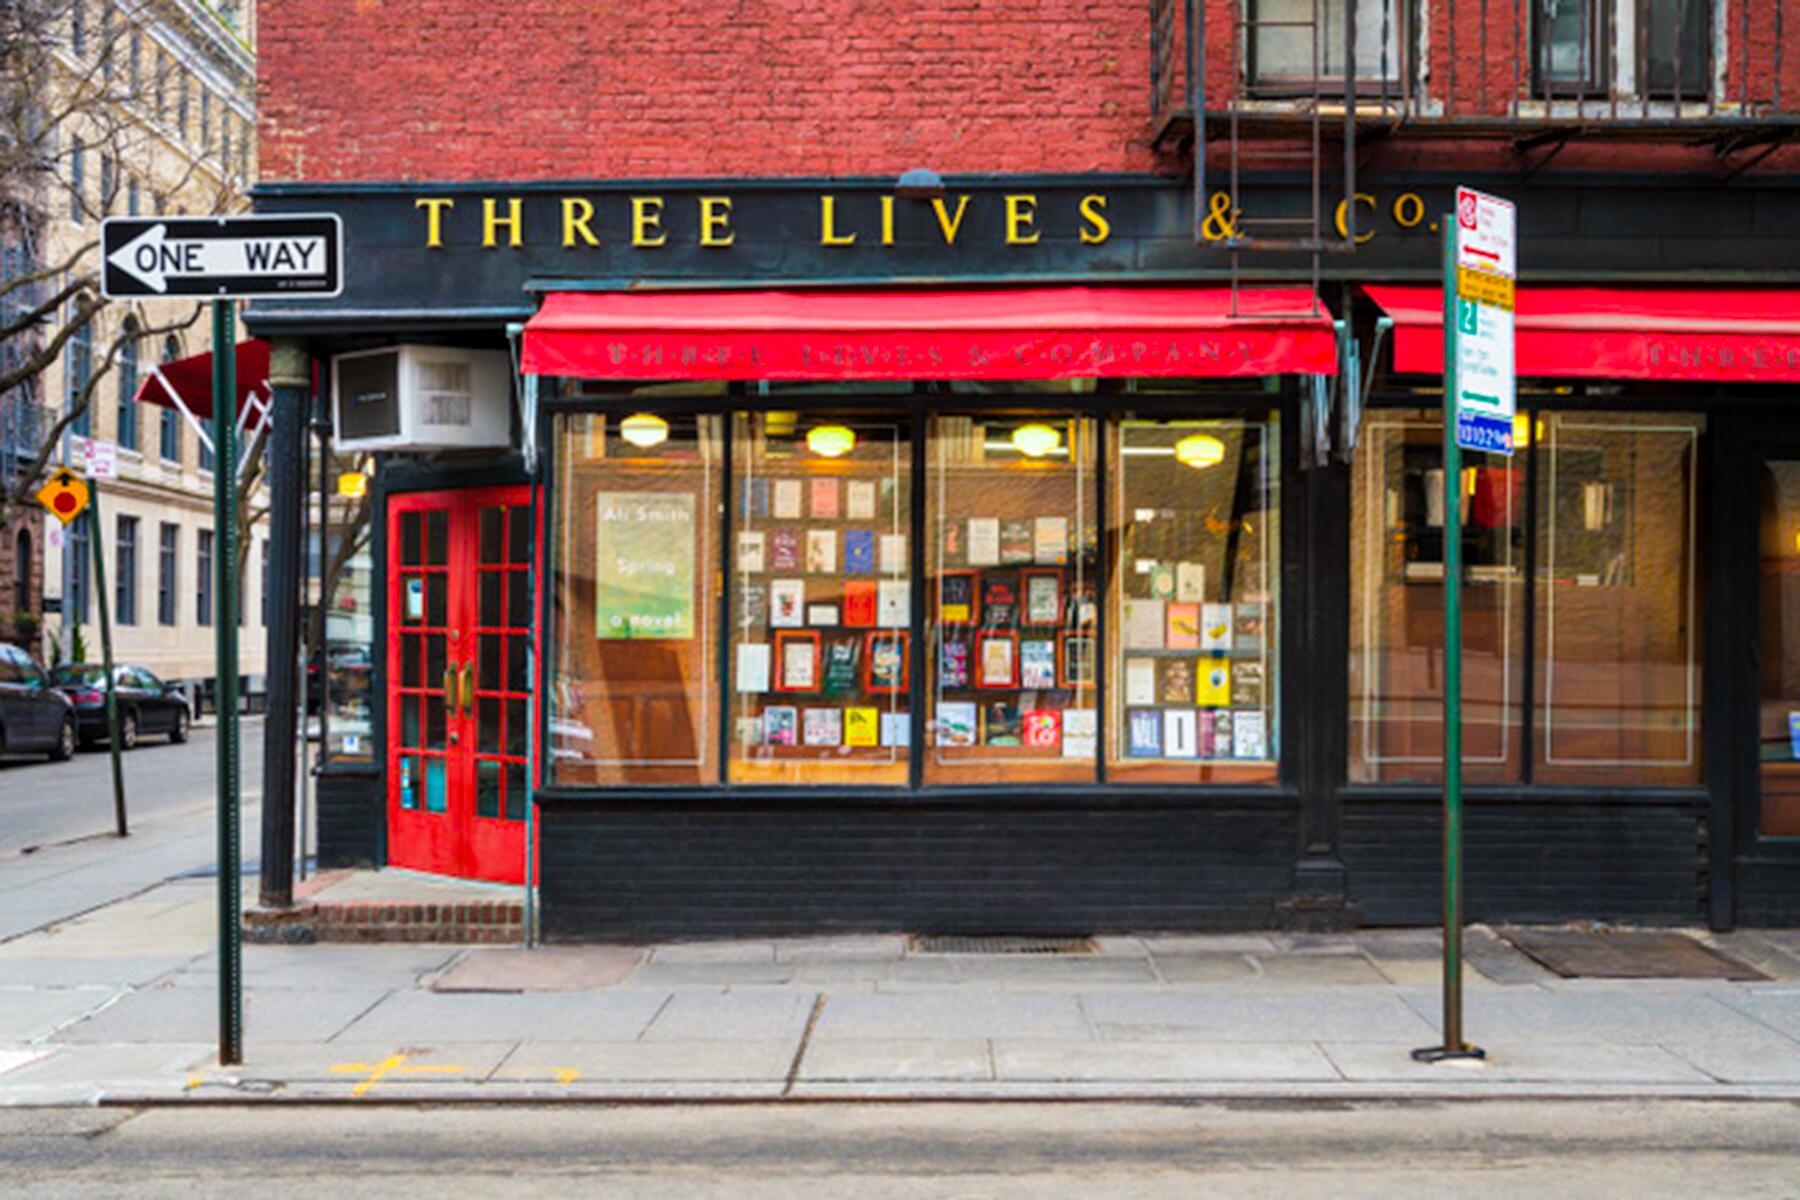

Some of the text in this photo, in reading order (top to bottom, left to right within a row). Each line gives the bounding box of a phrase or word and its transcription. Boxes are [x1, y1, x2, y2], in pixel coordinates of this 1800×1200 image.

[415, 197, 736, 248] THREE
[820, 194, 1112, 246] LIVES
[1201, 192, 1245, 241] &
[135, 241, 317, 273] ONE WAY
